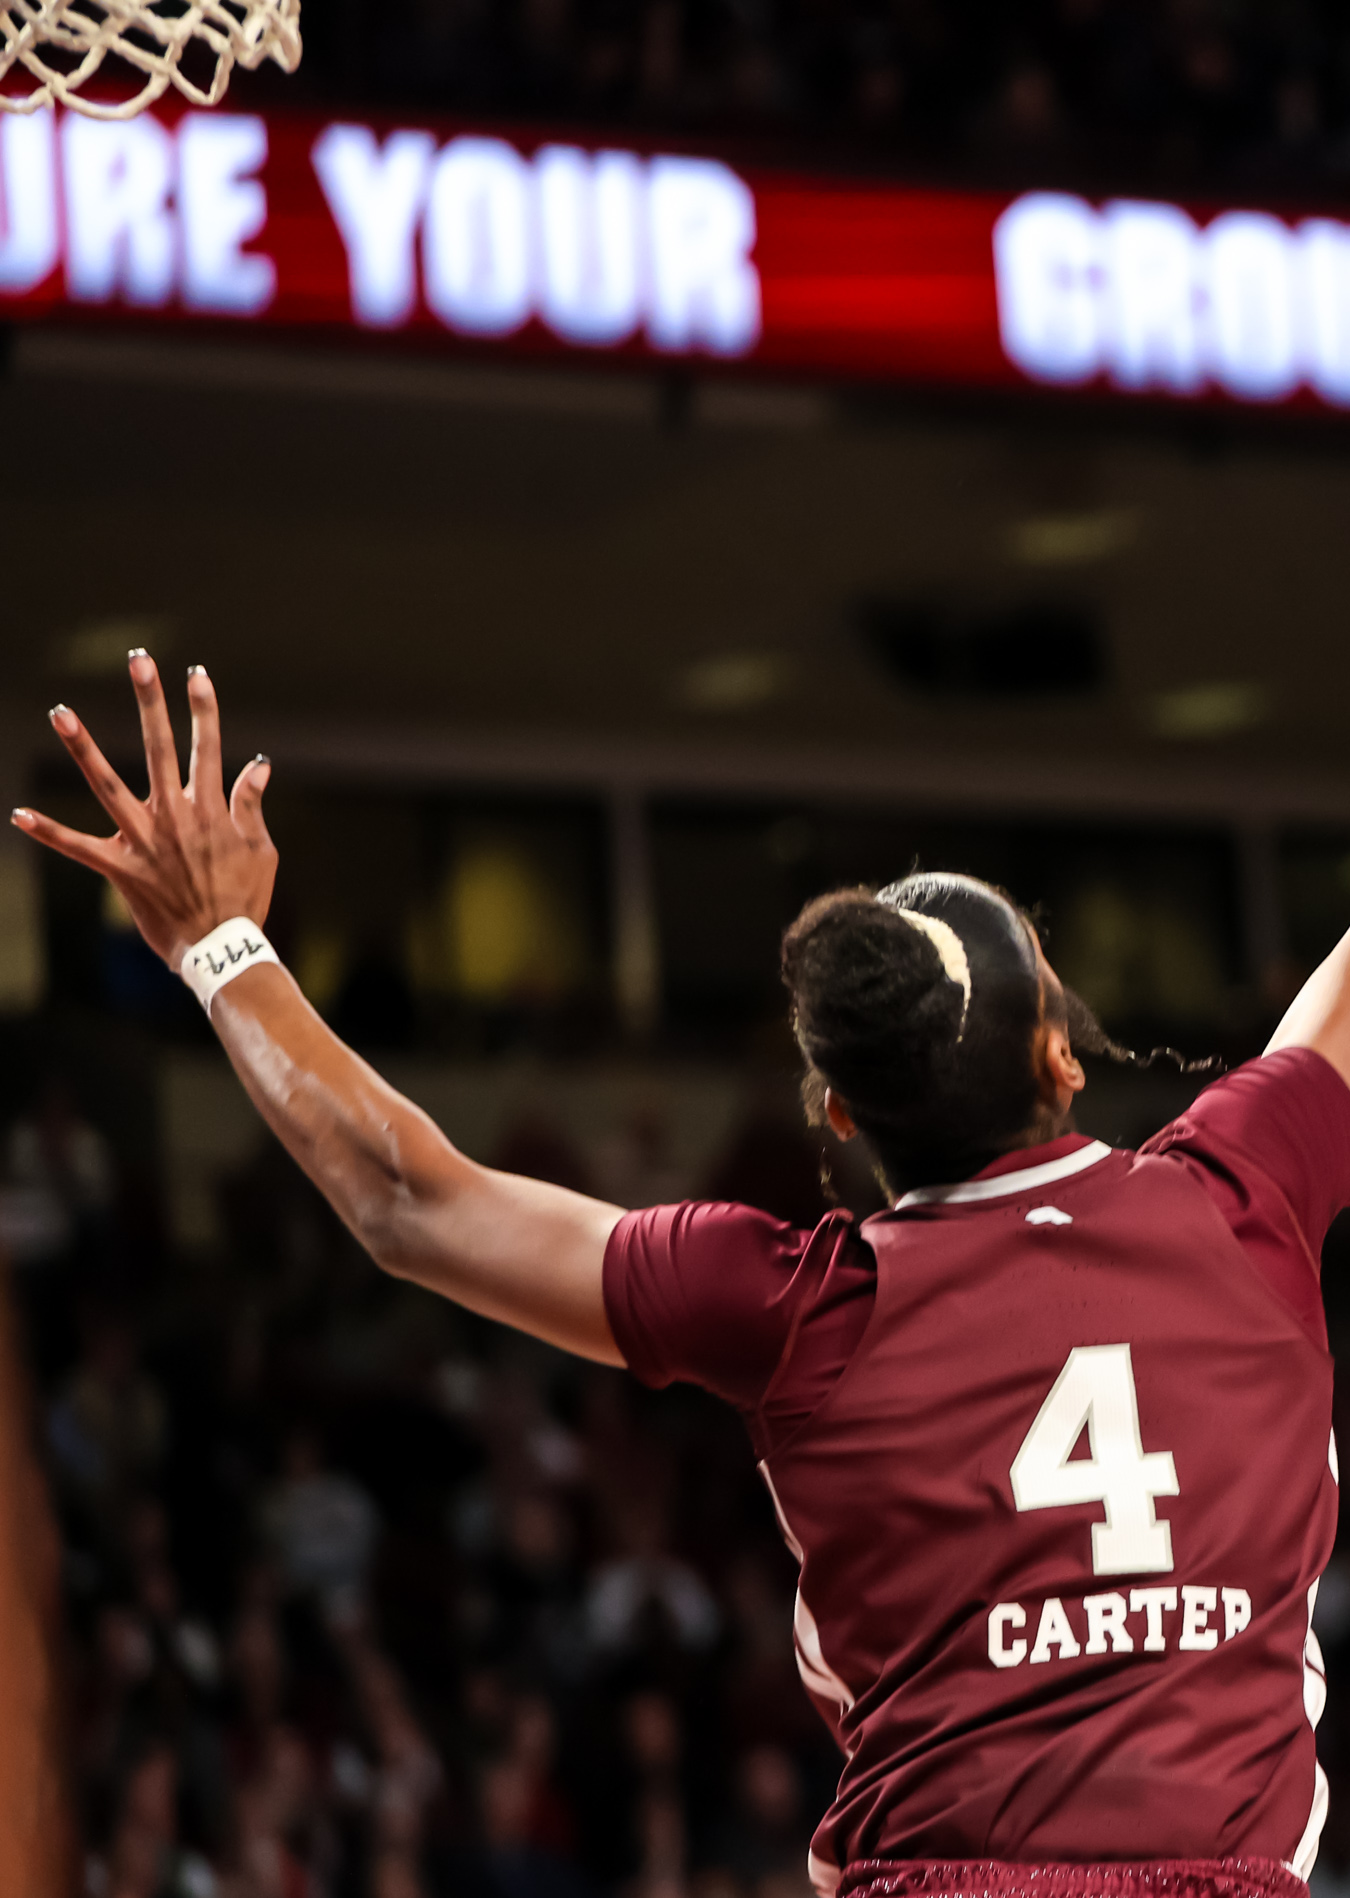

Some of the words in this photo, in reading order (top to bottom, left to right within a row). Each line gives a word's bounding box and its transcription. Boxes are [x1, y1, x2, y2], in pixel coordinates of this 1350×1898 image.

[312, 124, 762, 355] YOUR
[1009, 1343, 1180, 1576] 4
[987, 1585, 1252, 1668] CARTER
